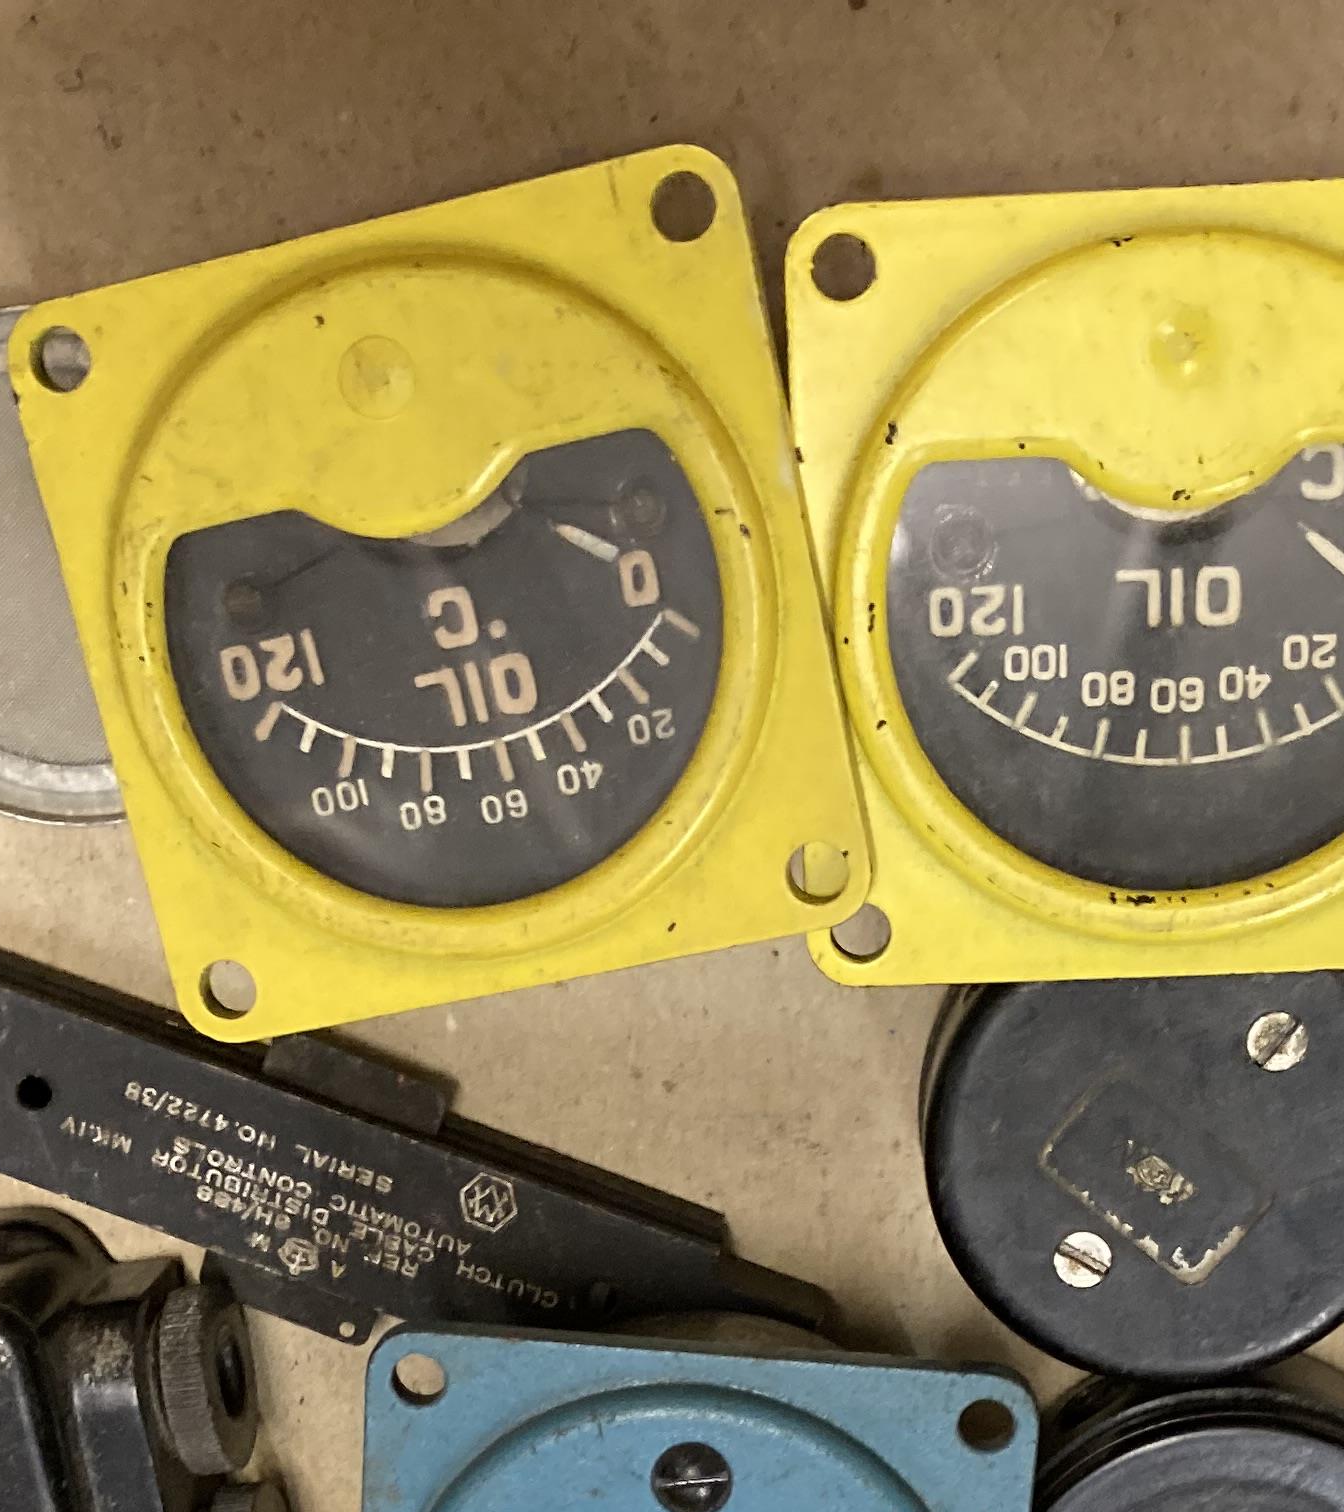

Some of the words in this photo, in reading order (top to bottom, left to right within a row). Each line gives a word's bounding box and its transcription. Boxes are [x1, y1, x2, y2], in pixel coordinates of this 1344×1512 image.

[618, 549, 660, 607] 0
[1115, 566, 1242, 628] OIL
[929, 584, 1025, 637] 120
[220, 629, 325, 701] 120
[1004, 644, 1068, 682] 100
[1283, 634, 1338, 671] 20
[413, 652, 538, 727] OIL
[1082, 671, 1136, 708] 80
[1150, 677, 1204, 714] 60
[1219, 666, 1272, 701] 40
[627, 708, 676, 745] 20
[312, 779, 371, 817] 100
[557, 761, 604, 796] 40
[400, 794, 447, 831] 80
[481, 789, 529, 824] 60
[151, 1148, 330, 1225] DISTRIBUTOR
[173, 1136, 312, 1199] CONTROLS
[295, 1143, 393, 1194] SERIAL
[329, 1194, 472, 1256] AUTOMATIC
[349, 1219, 435, 1262] CABLE
[456, 1260, 559, 1308] CLUTCH
